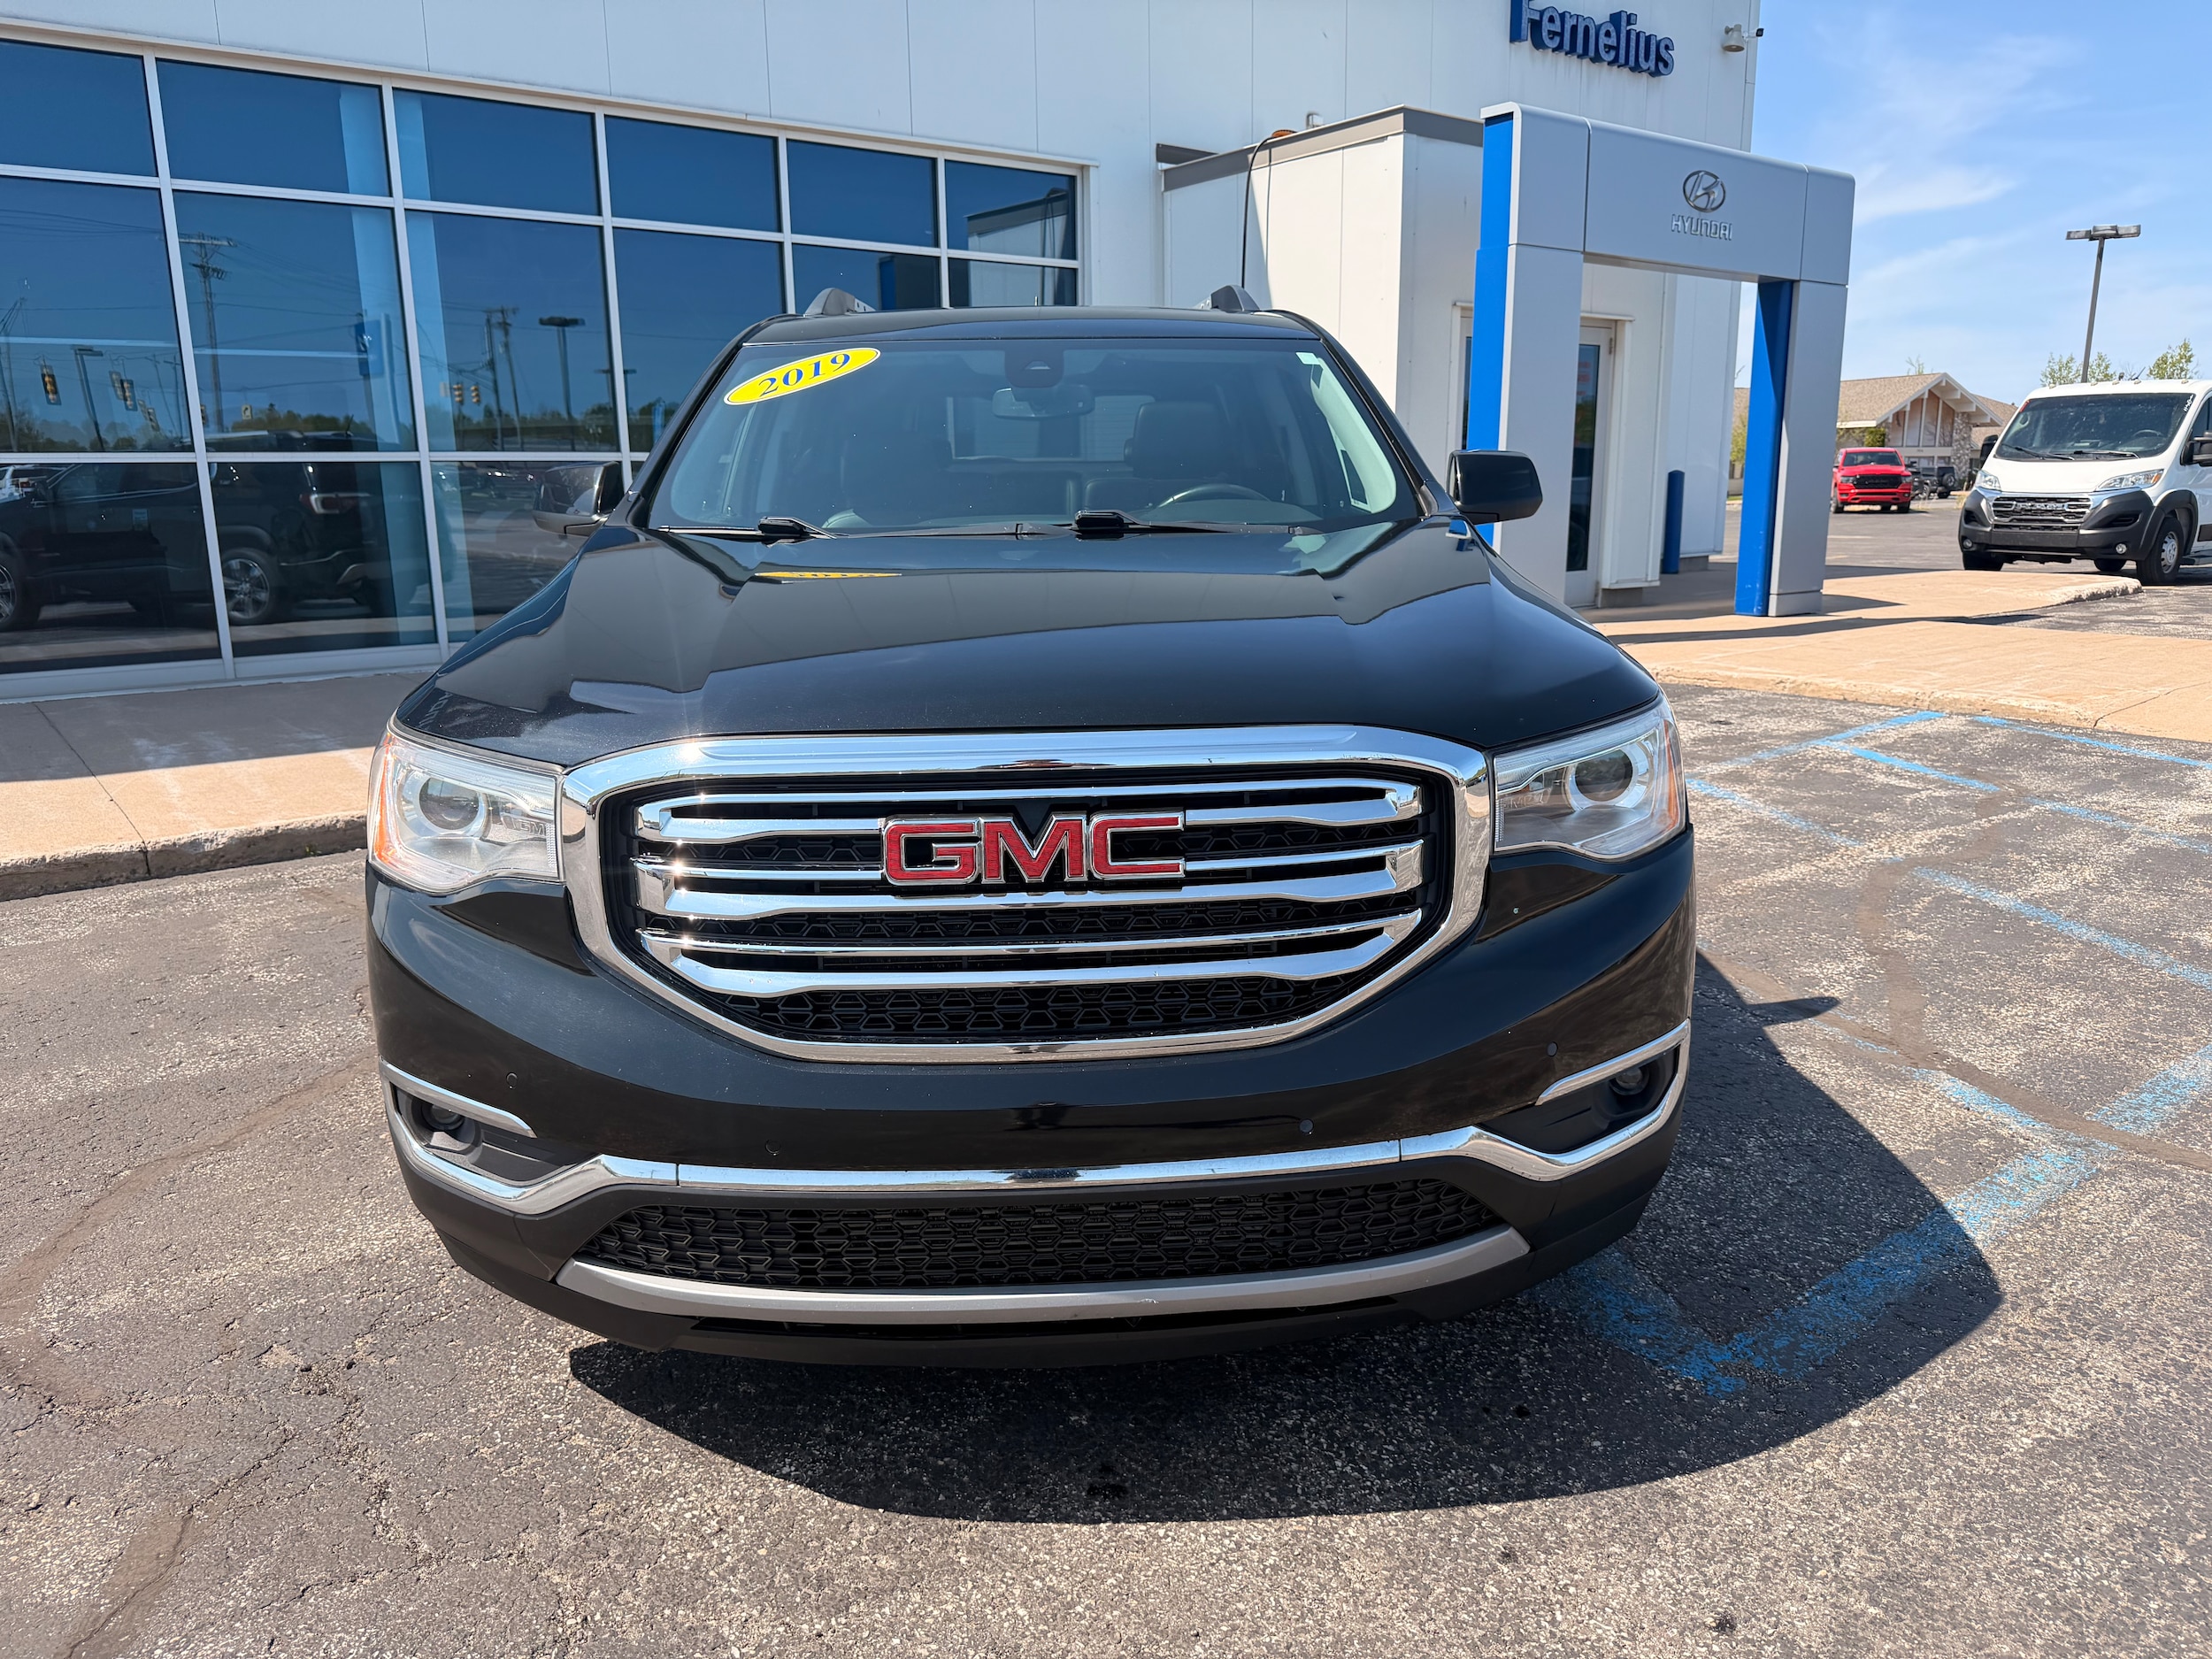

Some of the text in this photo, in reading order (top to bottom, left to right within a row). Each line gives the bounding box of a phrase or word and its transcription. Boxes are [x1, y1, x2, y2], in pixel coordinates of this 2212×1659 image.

[1509, 0, 1675, 78] Fernelius
[1671, 213, 1732, 241] HYUNDAI
[758, 353, 850, 397] 2019
[884, 810, 1186, 886] GMC
